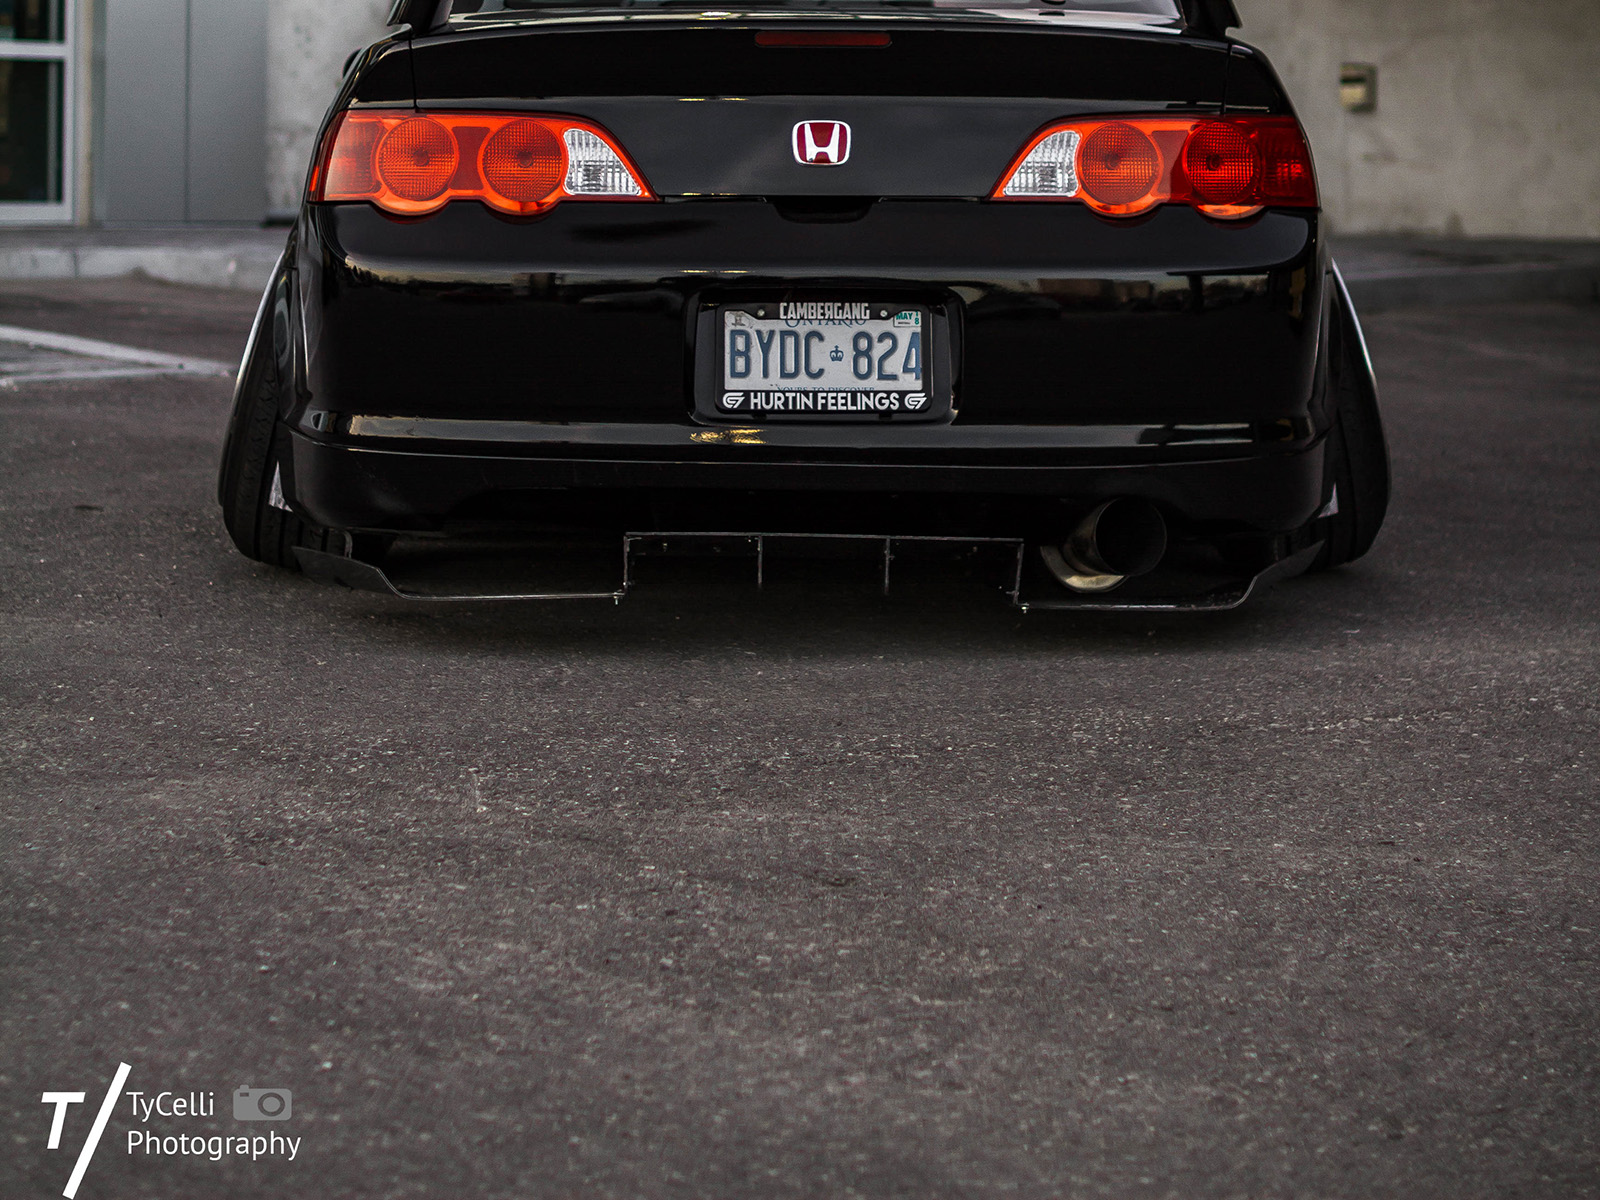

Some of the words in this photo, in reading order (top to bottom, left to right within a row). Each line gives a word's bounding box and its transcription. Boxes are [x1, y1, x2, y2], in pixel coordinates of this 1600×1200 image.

[779, 302, 870, 320] CAMBERGANG
[895, 312, 913, 320] MAY
[729, 329, 825, 380] BYDC
[852, 330, 922, 381] 824
[750, 392, 813, 410] HURTIN
[817, 391, 900, 411] FEELINGS
